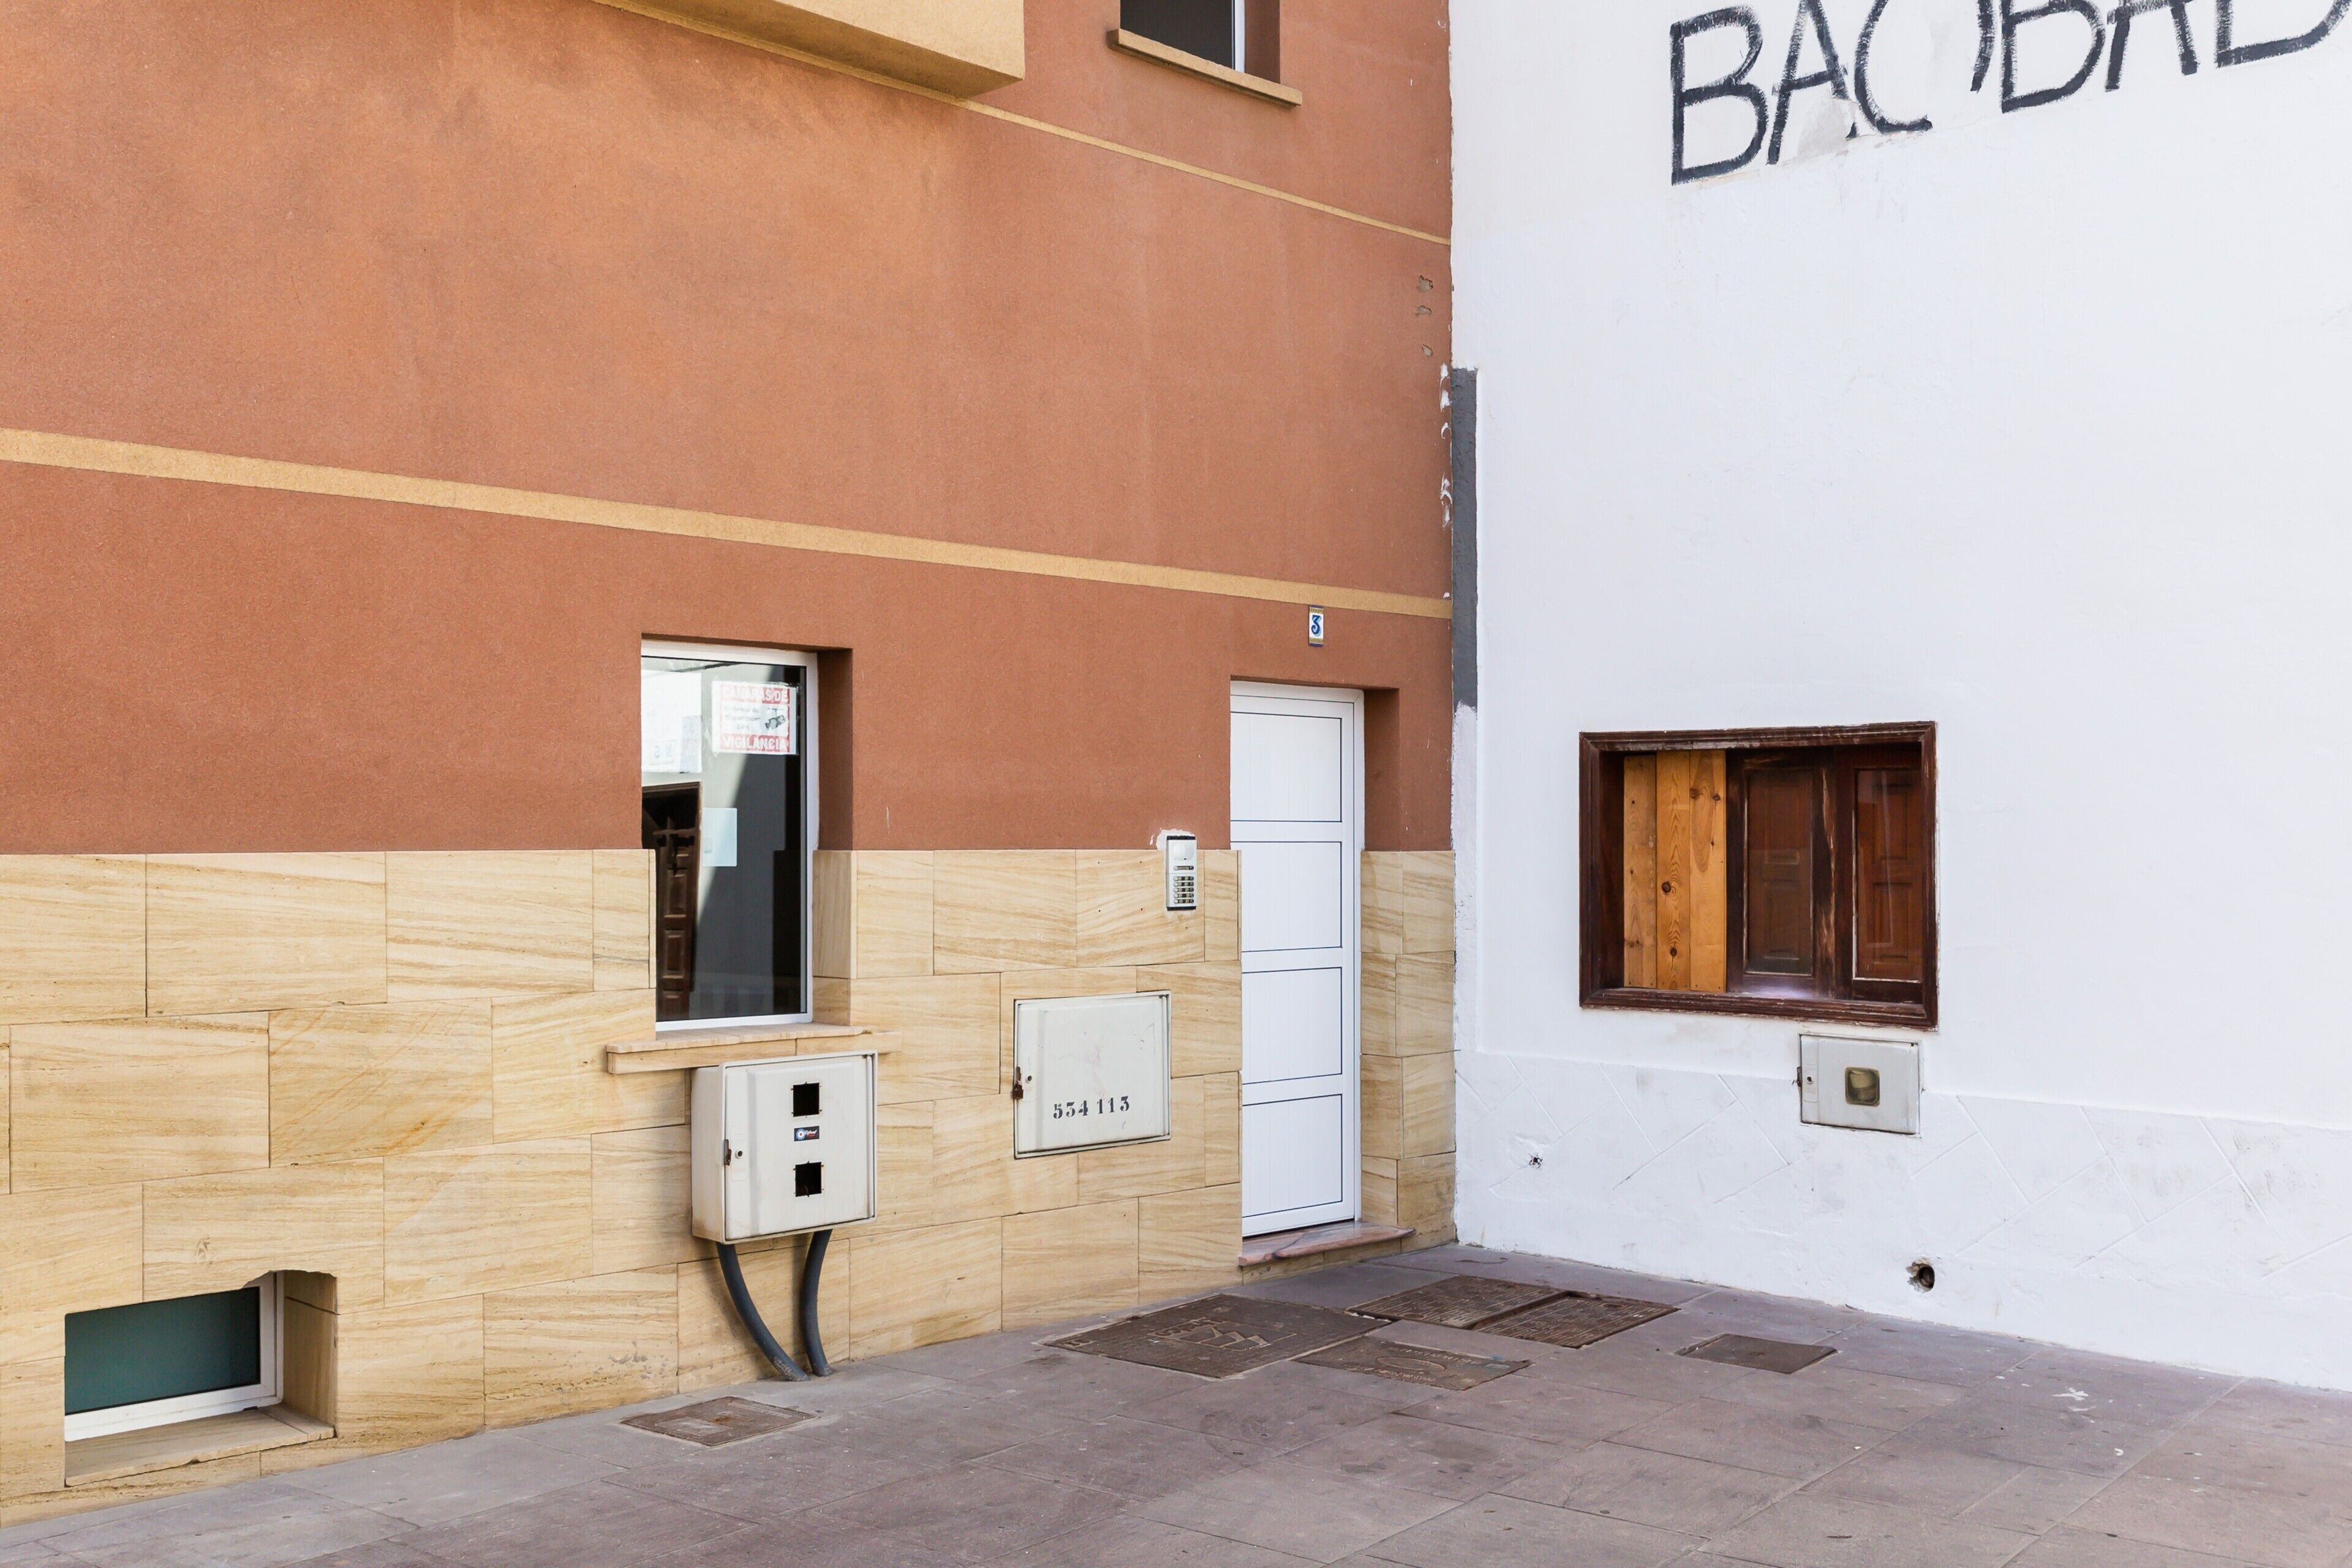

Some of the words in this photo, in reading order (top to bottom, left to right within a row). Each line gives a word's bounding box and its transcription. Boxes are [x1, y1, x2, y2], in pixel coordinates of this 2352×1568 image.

[1311, 614, 1322, 637] 3
[773, 688, 788, 703] DE
[723, 735, 788, 751] VIGILANCIA
